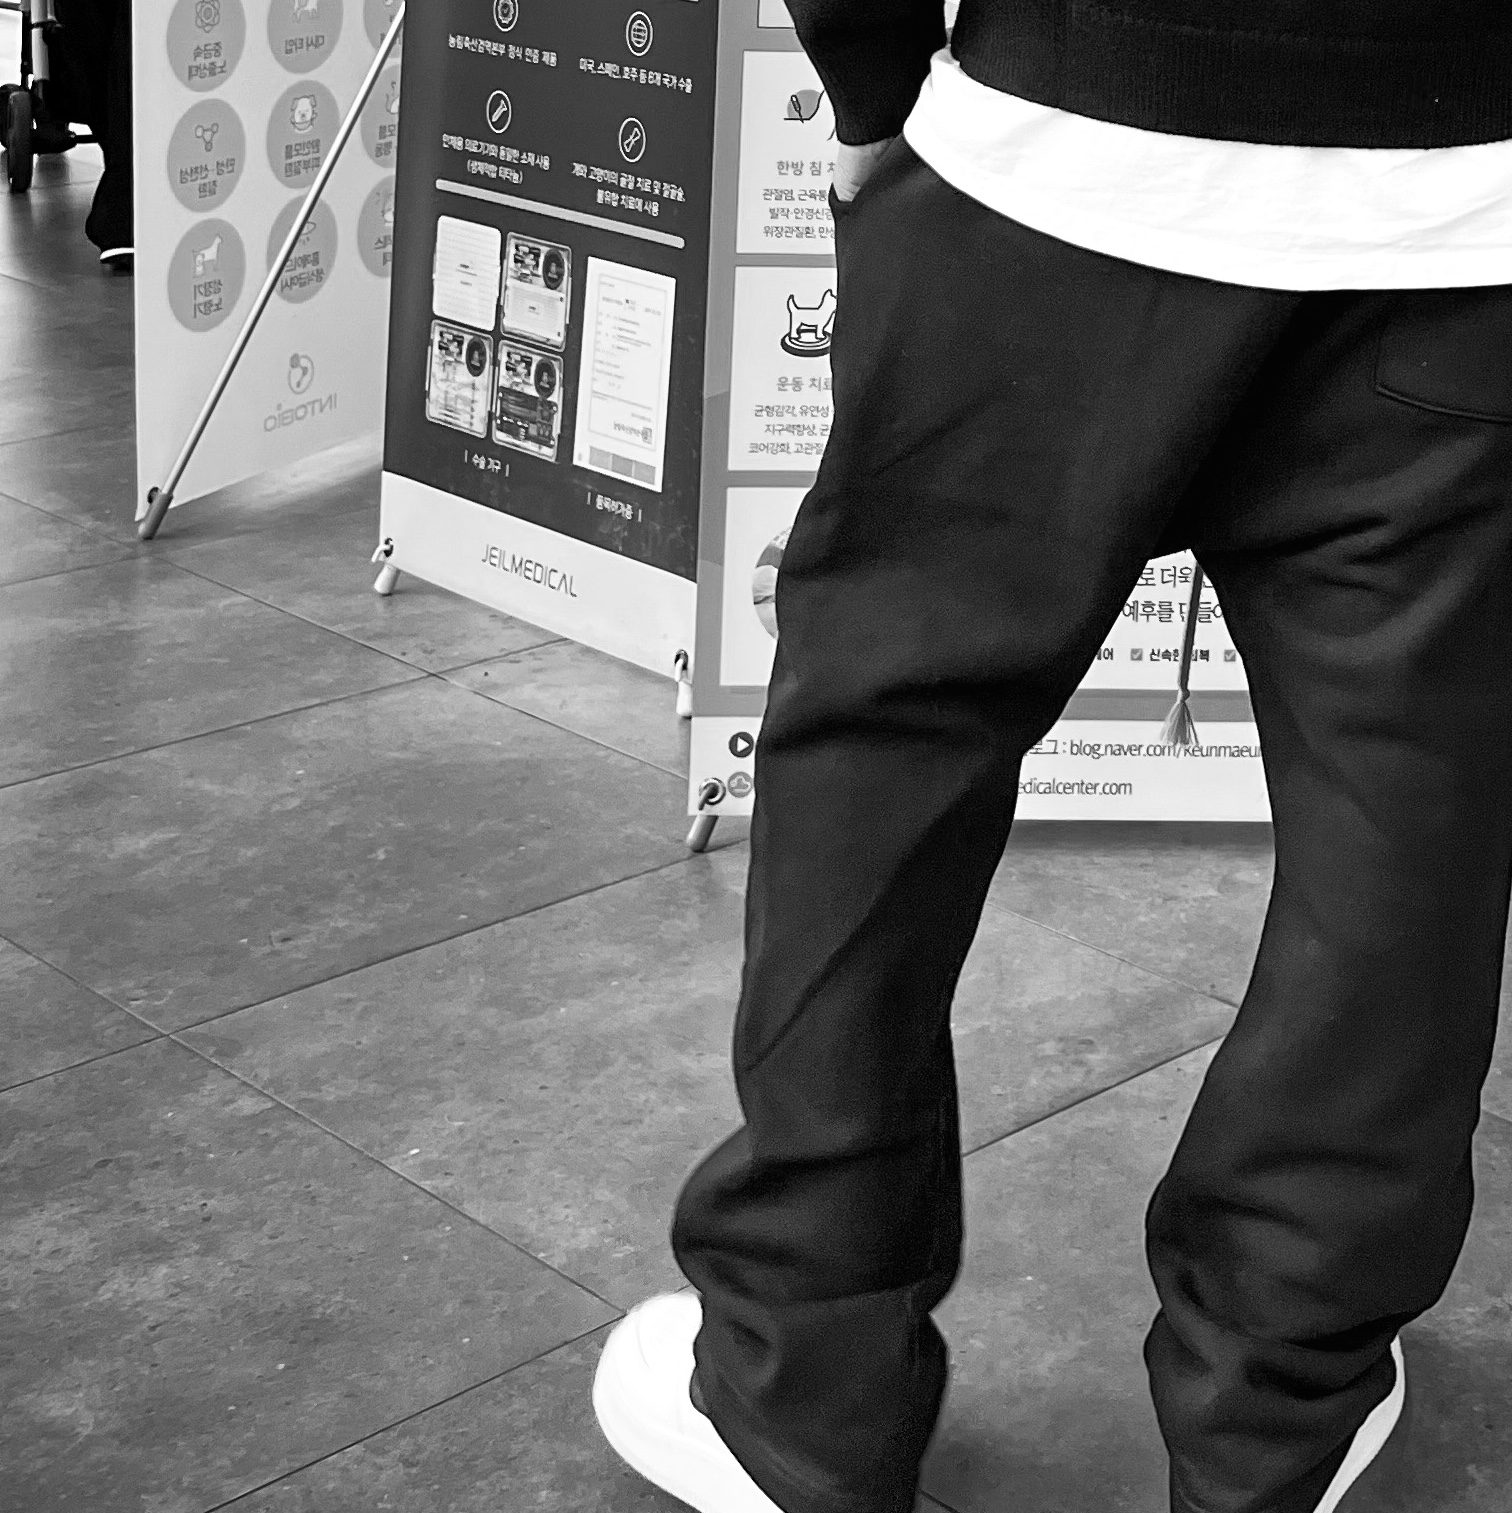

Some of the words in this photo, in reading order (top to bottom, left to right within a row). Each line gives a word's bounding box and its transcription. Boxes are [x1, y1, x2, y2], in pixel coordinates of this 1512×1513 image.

[776, 160, 804, 176] 한방
[810, 160, 822, 176] 침
[776, 376, 804, 392] 운동
[481, 544, 578, 598] JEILMEDICAL
[1122, 600, 1174, 623] 예후를
